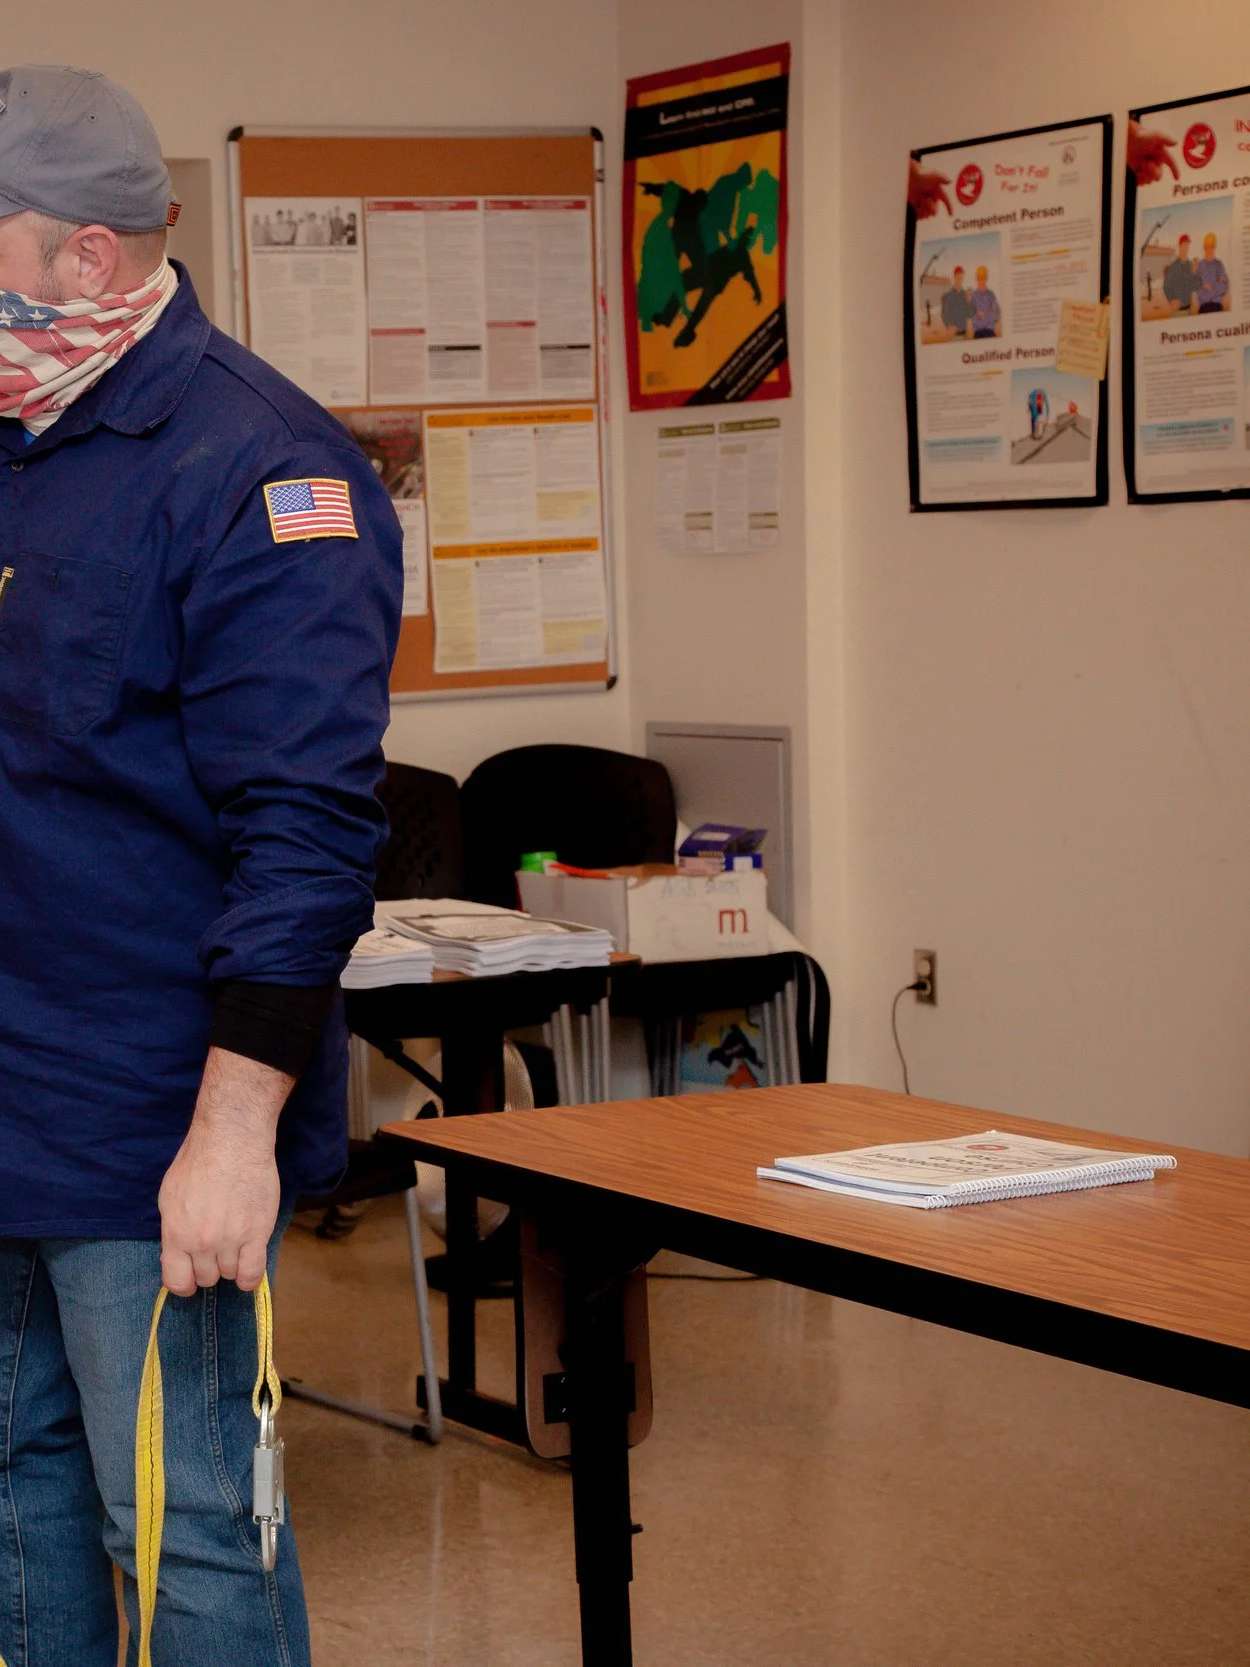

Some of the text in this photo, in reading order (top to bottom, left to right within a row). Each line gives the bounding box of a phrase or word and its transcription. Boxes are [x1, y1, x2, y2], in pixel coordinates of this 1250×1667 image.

[1172, 179, 1229, 197] Persona
[953, 206, 1065, 231] Competent Person
[1160, 328, 1211, 344] Persona
[962, 347, 1055, 365] Qualified Person
